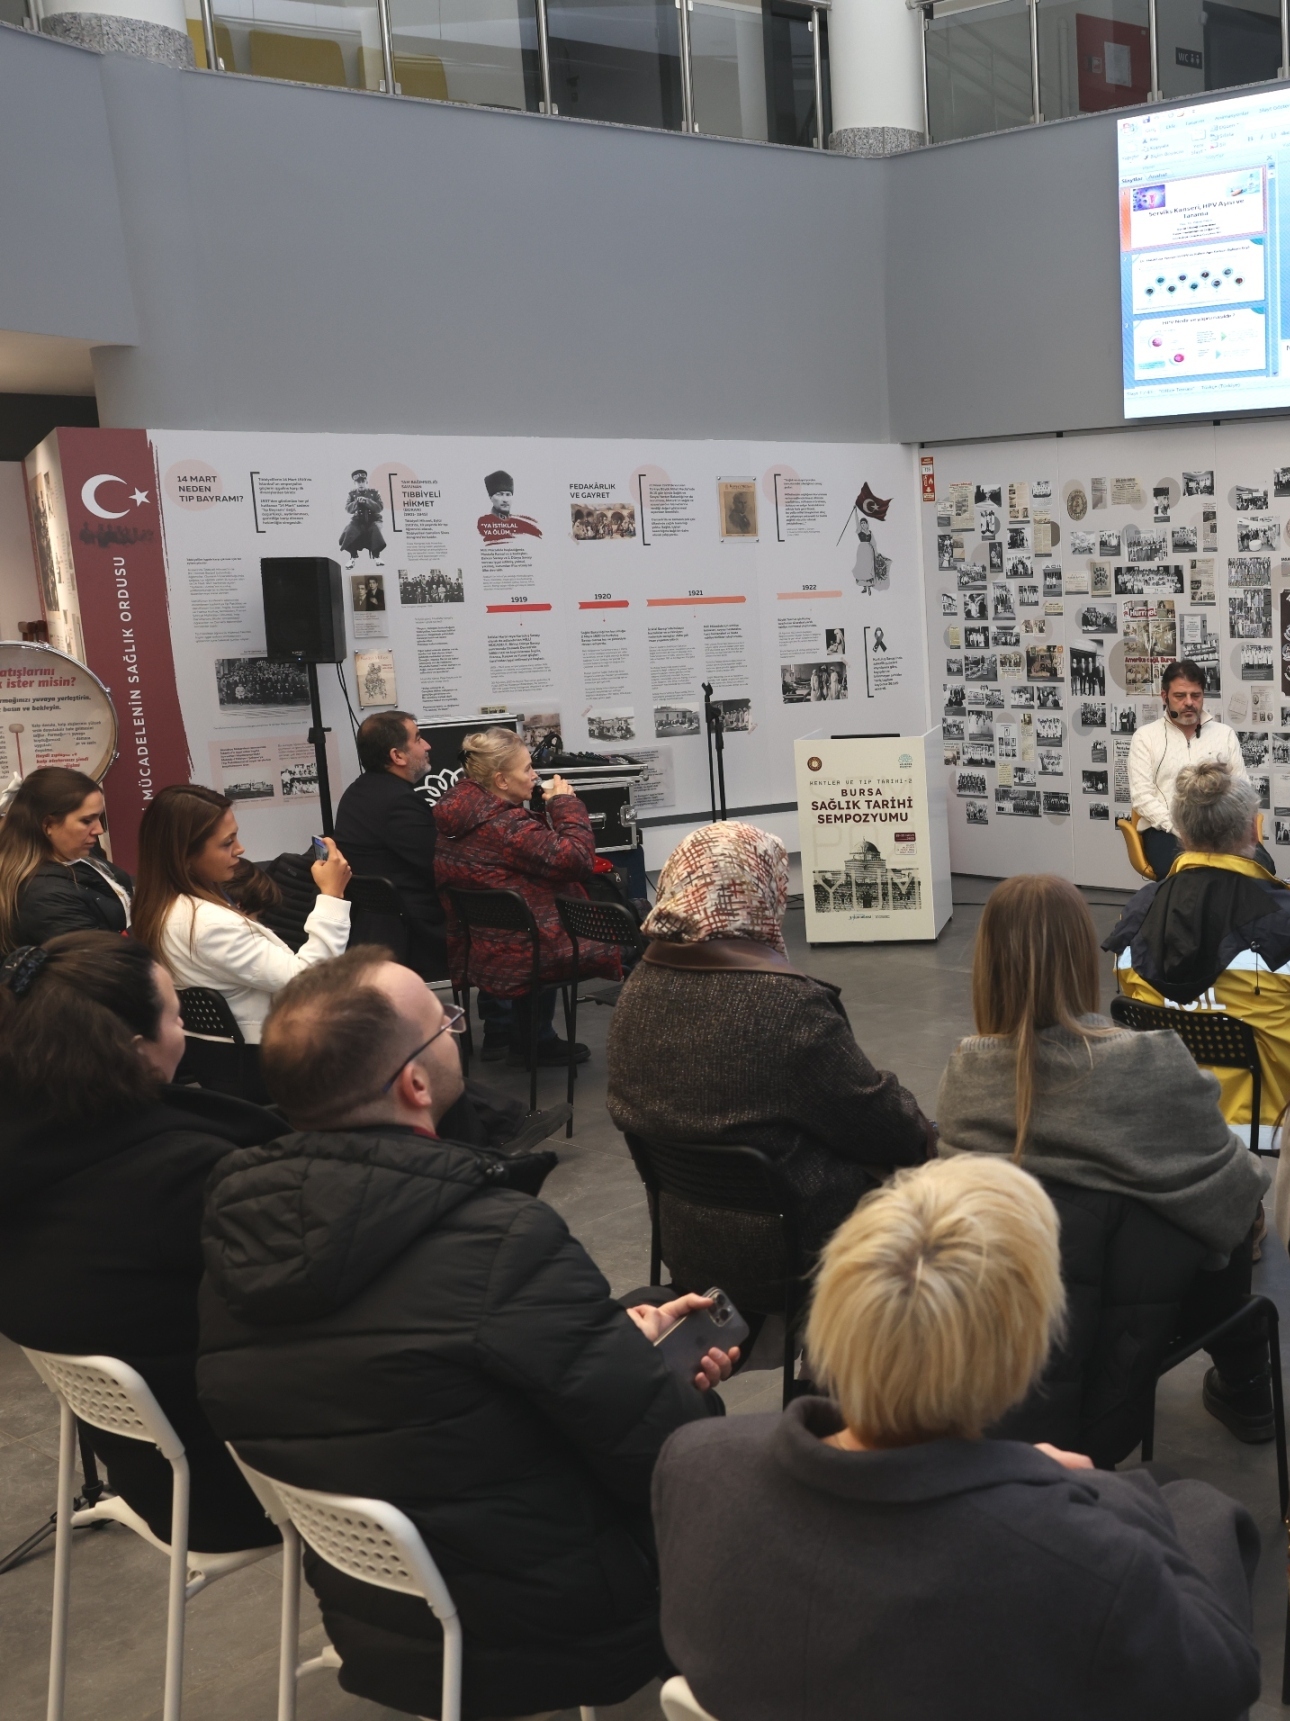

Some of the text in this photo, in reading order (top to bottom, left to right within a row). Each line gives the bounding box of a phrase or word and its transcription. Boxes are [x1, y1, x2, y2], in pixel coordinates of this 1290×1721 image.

[1178, 53, 1189, 63] WC
[190, 475, 217, 483] MART
[178, 485, 211, 493] NEDEN
[569, 482, 616, 490] FEDAKÂRLIK
[402, 489, 441, 498] TIBBİYELİ
[581, 491, 610, 499] GAYRET
[179, 495, 243, 503] TIP BAYRAMI?
[403, 499, 435, 507] HİKMET
[113, 556, 153, 799] MÜCADELENİN SAĞLIK ORDUSU
[7, 677, 76, 688] ister misin?
[841, 788, 882, 797] BURSA
[811, 796, 913, 811] SAĞLIK TARİHİ
[818, 812, 908, 824] SEMPOZYUMU
